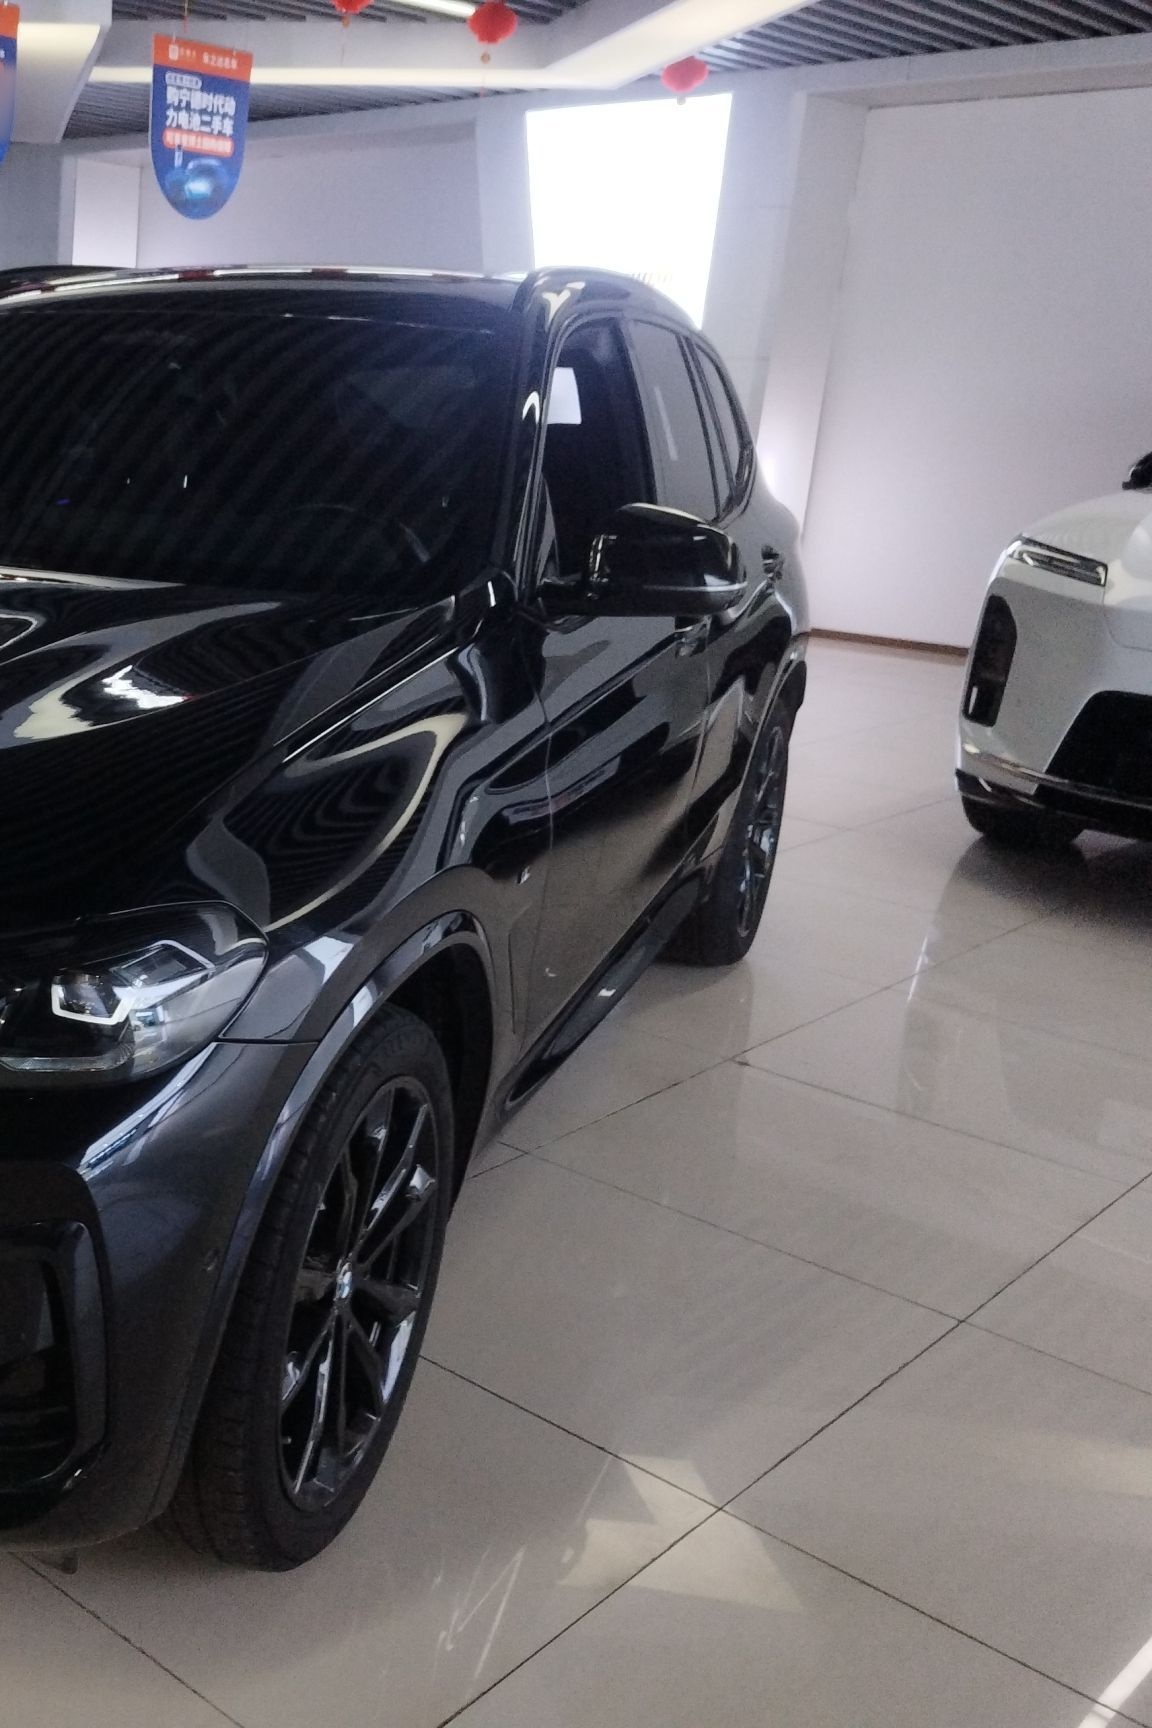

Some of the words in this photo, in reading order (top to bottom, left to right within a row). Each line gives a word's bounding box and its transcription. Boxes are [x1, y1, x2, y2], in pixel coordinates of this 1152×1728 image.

[165, 109, 234, 136] 力电池二手车
